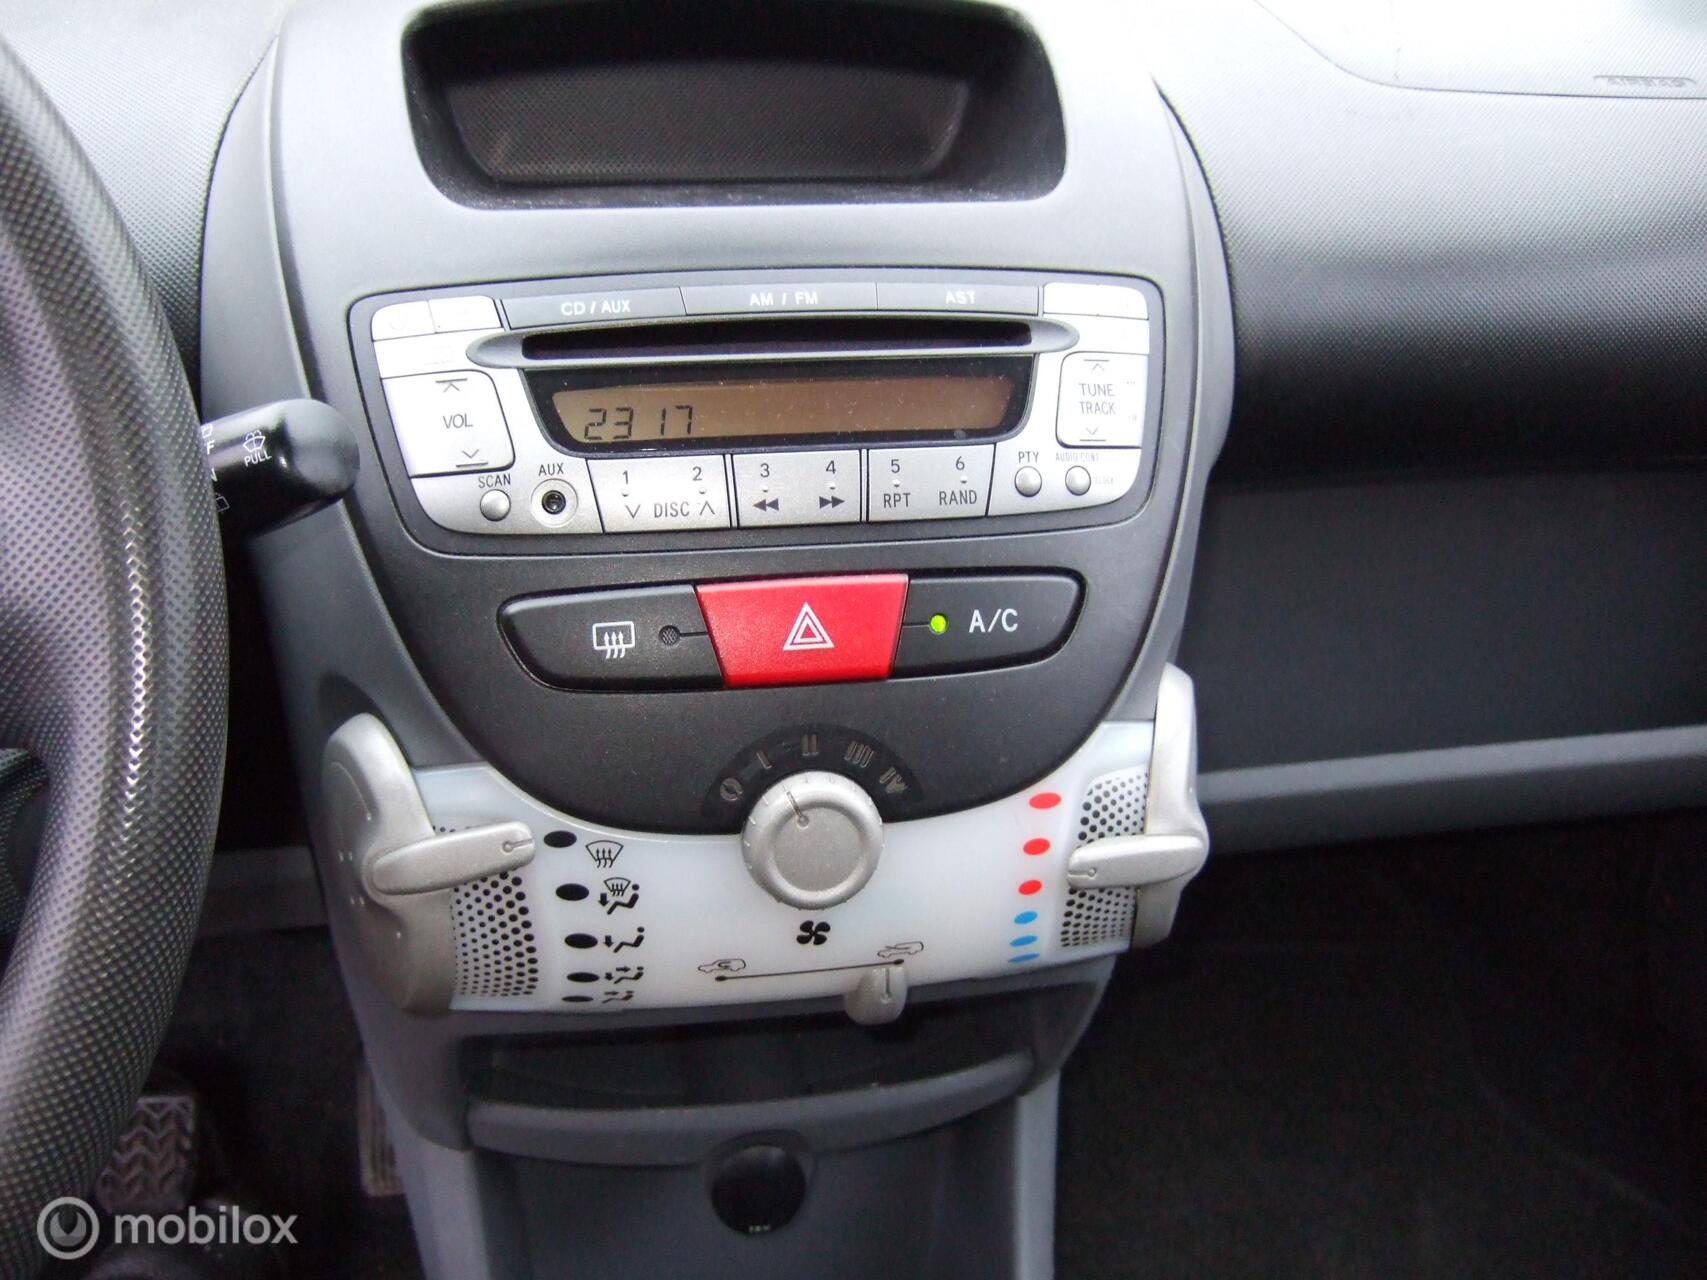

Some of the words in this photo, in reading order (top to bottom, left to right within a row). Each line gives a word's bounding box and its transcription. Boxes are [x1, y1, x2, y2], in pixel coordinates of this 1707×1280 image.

[749, 293, 774, 307] AM
[795, 292, 819, 305] FM
[945, 290, 975, 305] AST
[561, 302, 587, 316] CD
[602, 299, 632, 313] AUX
[1079, 384, 1115, 398] TUNE
[1079, 402, 1117, 416] TRACK
[442, 414, 473, 430] VOL
[244, 451, 272, 467] PULL
[955, 456, 966, 472] 6
[1018, 452, 1040, 464] PTY
[538, 463, 565, 477] AUX
[692, 466, 703, 482] 2
[759, 462, 770, 478] 3
[825, 459, 837, 475] 4
[890, 459, 901, 474] 5
[478, 474, 511, 490] SCAN
[621, 470, 630, 485] 1
[882, 493, 911, 509] RPT
[938, 491, 978, 506] RAND
[654, 502, 690, 518] DISC
[968, 608, 1018, 634] A/C
